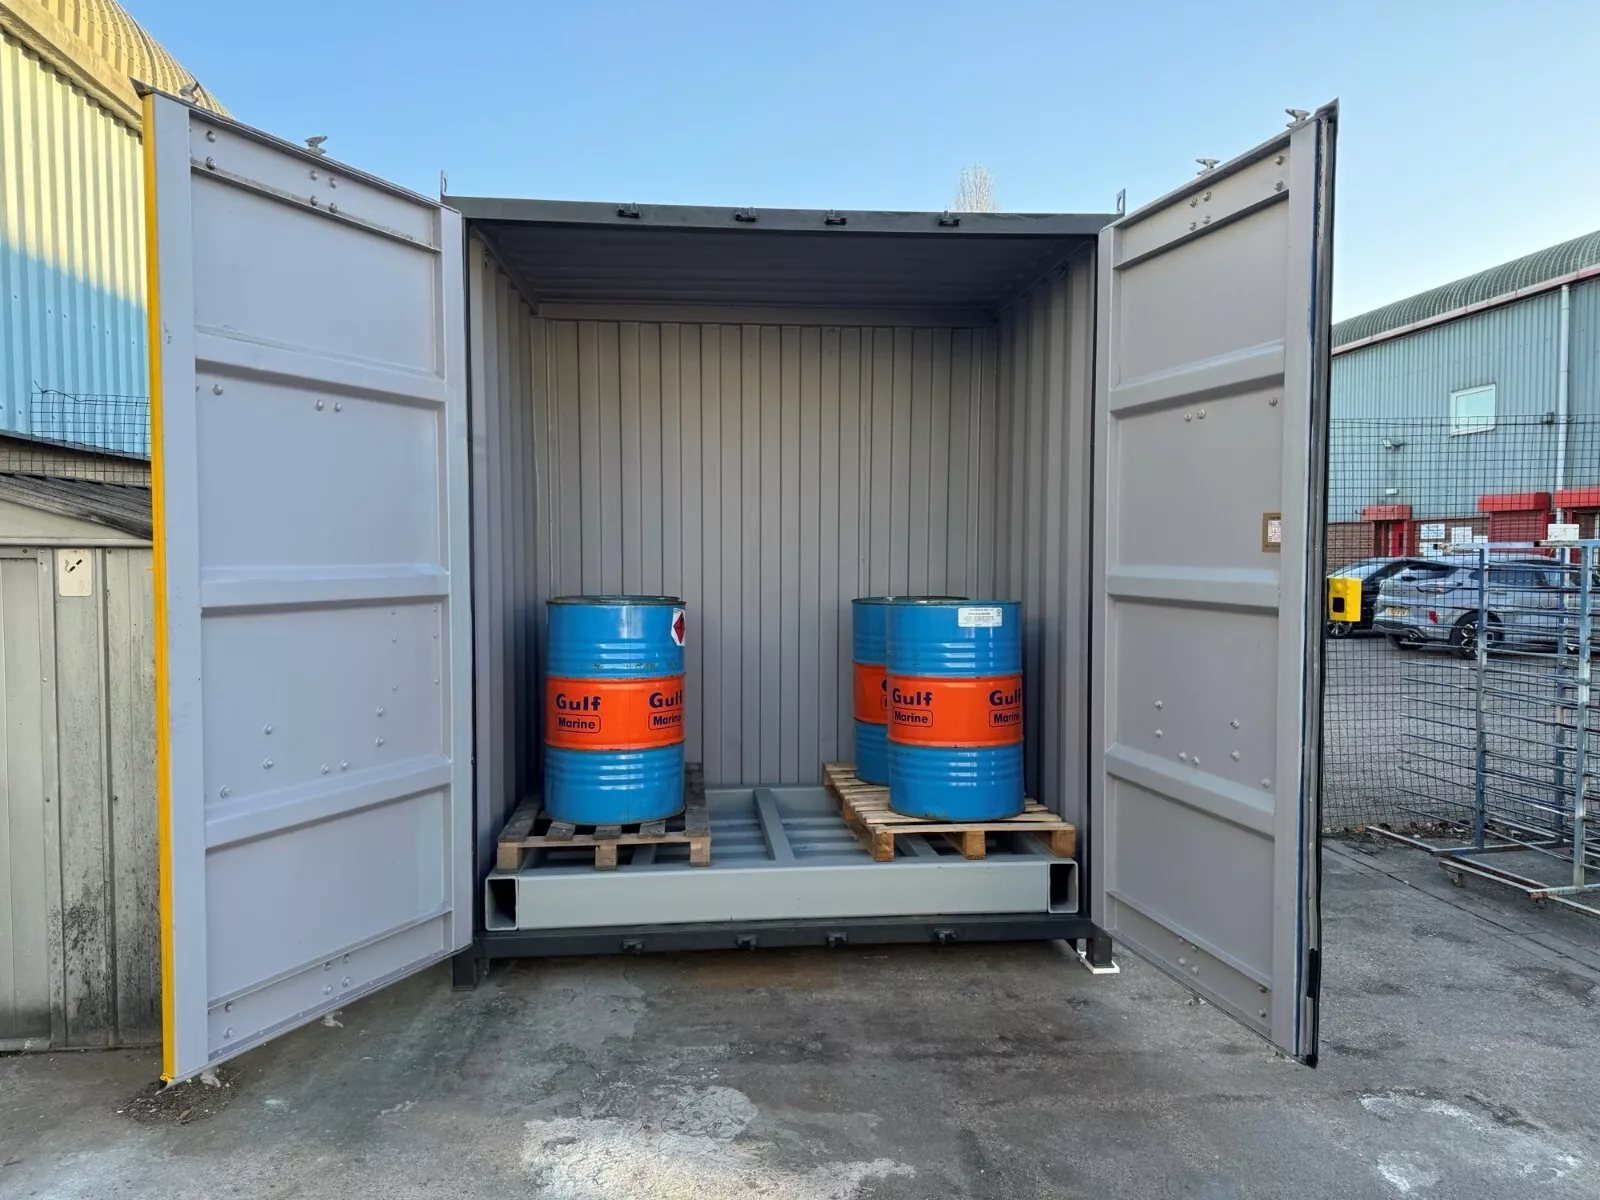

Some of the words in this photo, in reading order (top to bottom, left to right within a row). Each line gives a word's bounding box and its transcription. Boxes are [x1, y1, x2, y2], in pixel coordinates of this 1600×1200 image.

[556, 693, 601, 711] Gulf
[892, 687, 932, 706] Gulf
[558, 717, 595, 729] Marine
[894, 711, 928, 723] Marine
